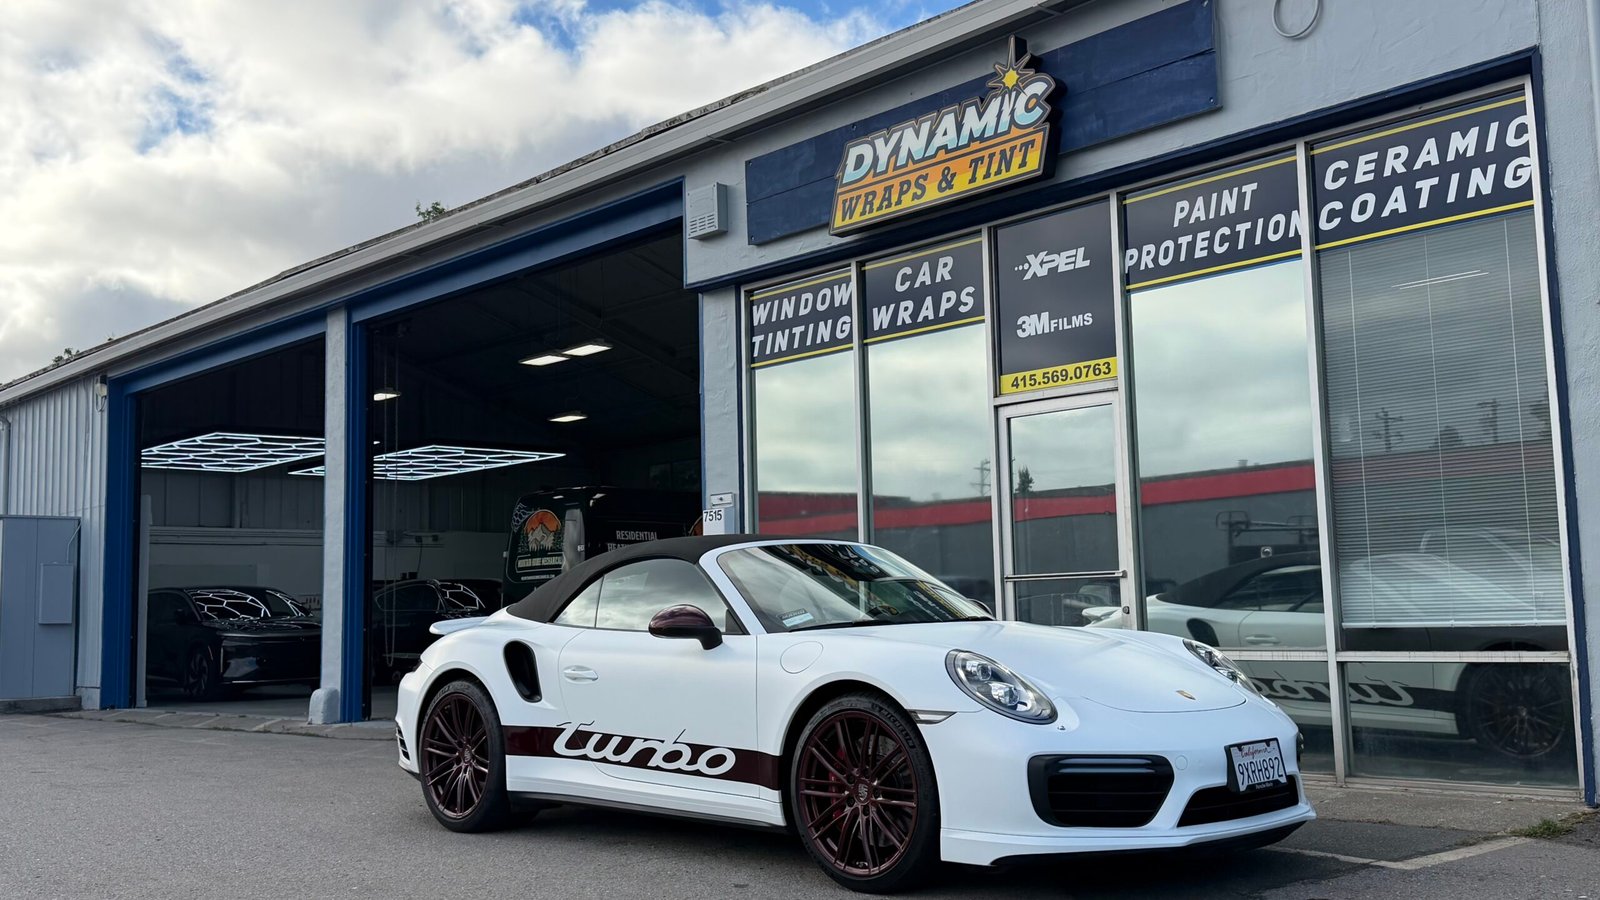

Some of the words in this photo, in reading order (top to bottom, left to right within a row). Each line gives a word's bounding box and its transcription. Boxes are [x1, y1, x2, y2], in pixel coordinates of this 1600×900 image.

[843, 81, 1048, 184] DYNAMIC
[1324, 115, 1530, 190] CERAMIC
[842, 172, 929, 223] WRAPS
[937, 166, 957, 193] &
[969, 138, 1037, 185] TINT
[1318, 156, 1533, 231] COATING
[1173, 182, 1258, 228] PAINT
[1022, 246, 1091, 281] XPEL
[1125, 209, 1302, 274] PROTECTION
[894, 255, 954, 293] CAR
[752, 281, 853, 327] WINDOW
[872, 286, 976, 331] WRAPS
[1016, 311, 1050, 338] 3M
[1050, 312, 1093, 333] FILMS
[752, 315, 852, 357] TINTING
[1011, 361, 1112, 389] 415.569.0763
[616, 530, 658, 541] RESIDENTIAL
[703, 509, 723, 522] 7515
[553, 720, 736, 776] turbo
[1237, 756, 1284, 786] 9XRH892
